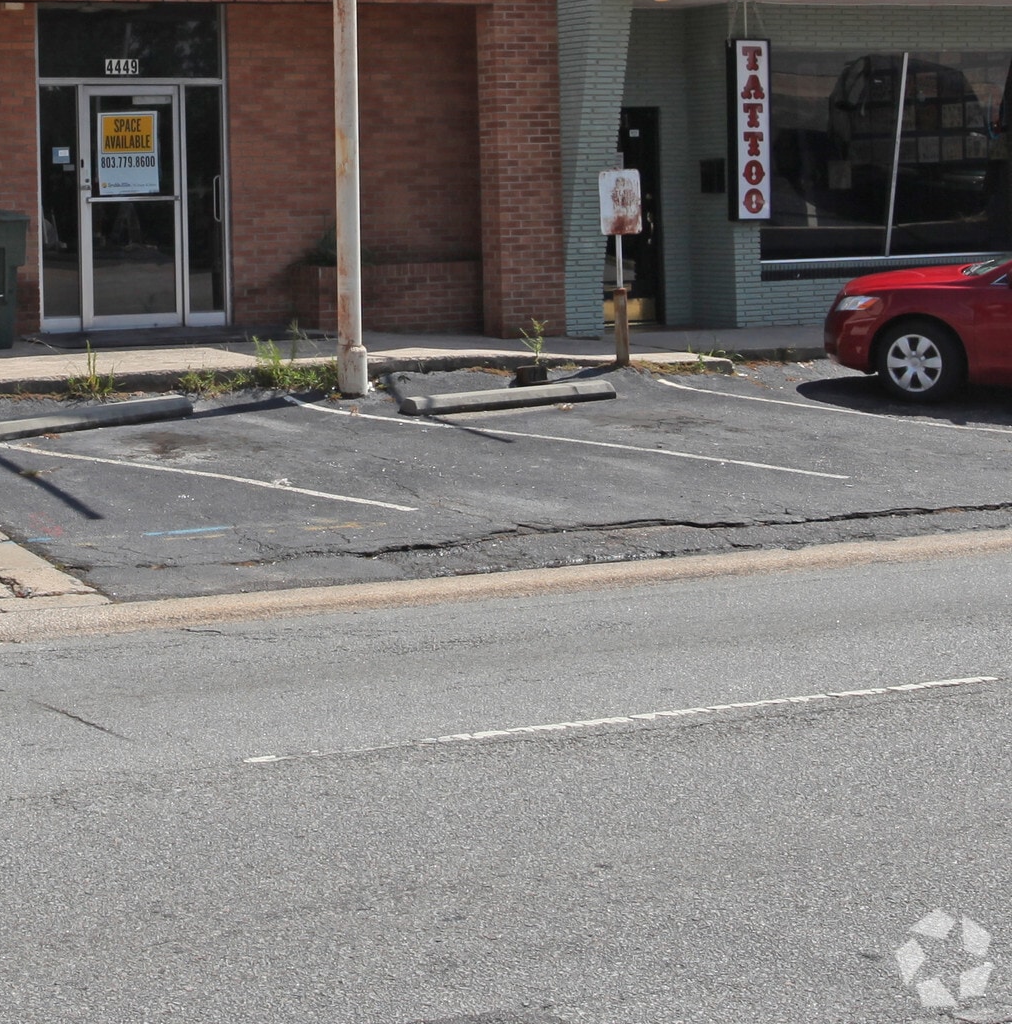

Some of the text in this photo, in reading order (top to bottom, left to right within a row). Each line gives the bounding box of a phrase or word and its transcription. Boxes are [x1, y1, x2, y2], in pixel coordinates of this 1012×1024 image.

[106, 59, 137, 74] 4449
[114, 118, 142, 133] SPACE
[741, 46, 765, 214] TATTOO
[104, 134, 151, 149] AVAILABLE
[100, 155, 156, 169] 803.779.8600
